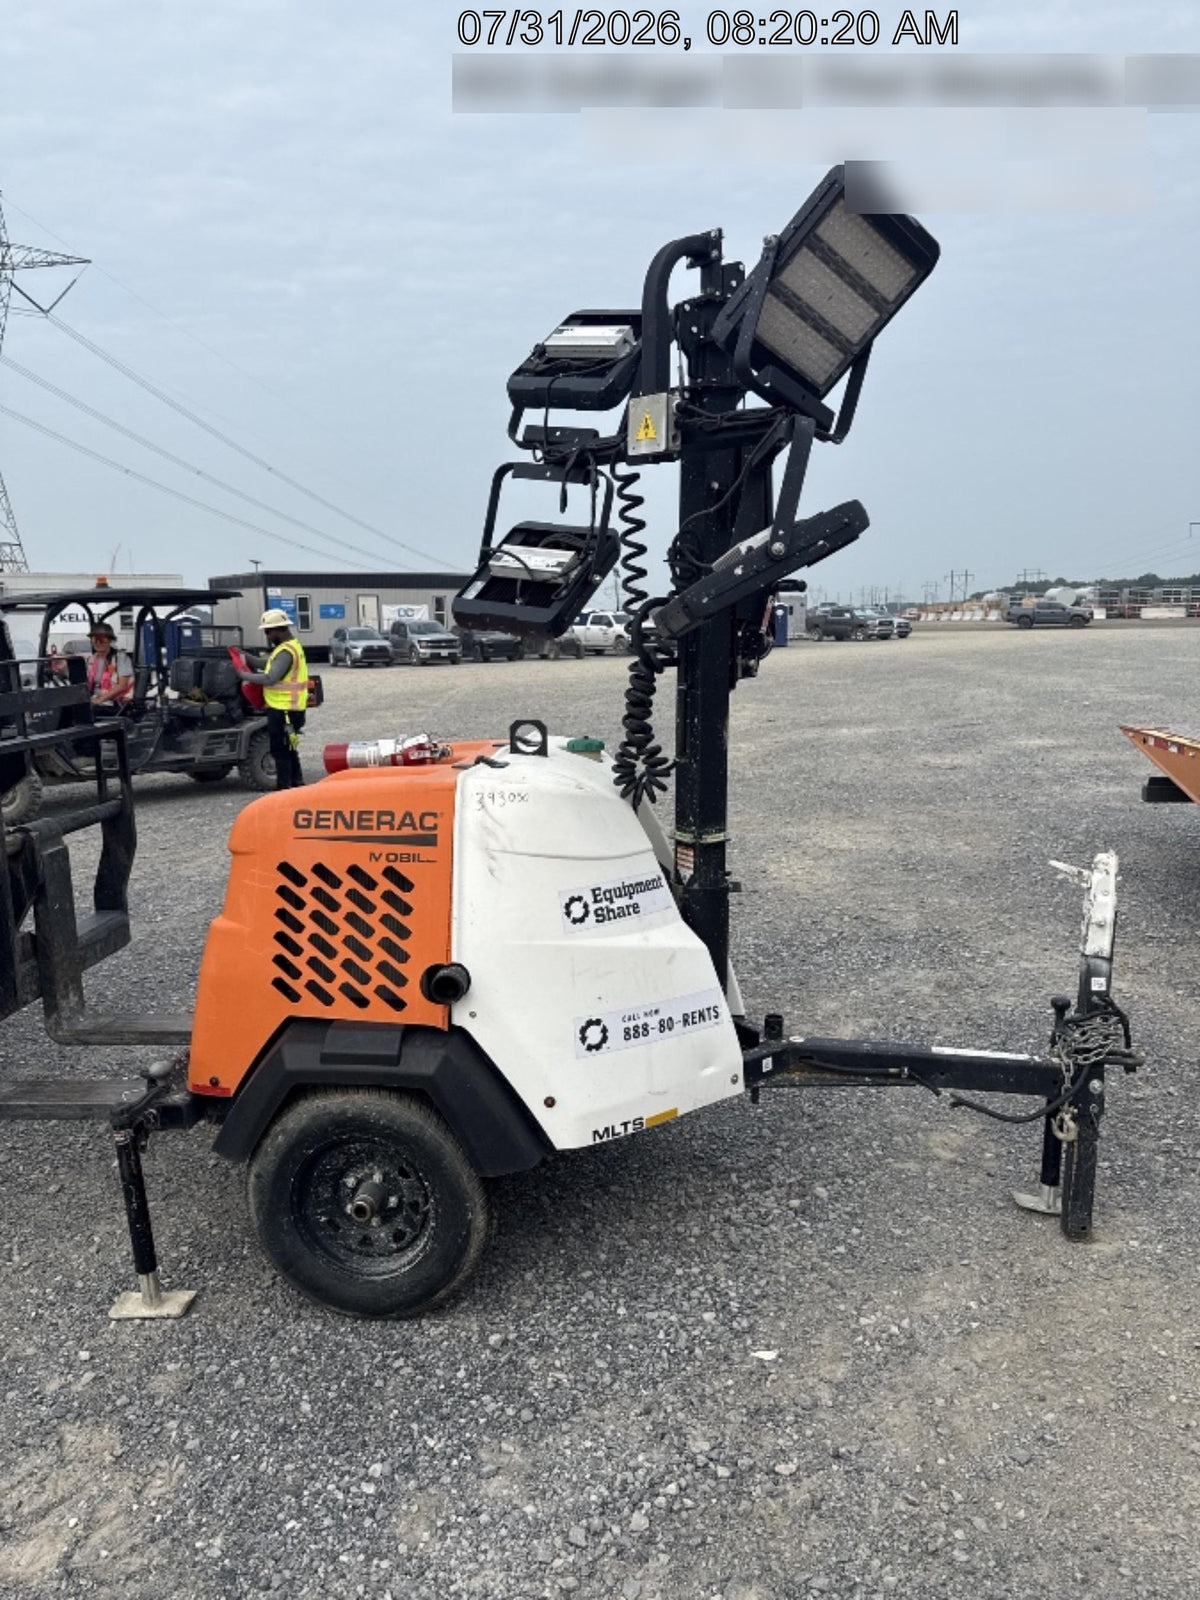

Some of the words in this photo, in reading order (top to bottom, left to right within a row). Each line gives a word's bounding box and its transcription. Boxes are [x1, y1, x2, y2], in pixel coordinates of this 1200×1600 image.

[60, 611, 104, 623] KELL
[292, 808, 439, 832] GENERAC
[368, 852, 438, 863] MOBIL
[590, 875, 664, 905] Equipment
[593, 901, 641, 924] Share
[622, 1005, 720, 1041] 888-80-RENTS
[592, 1116, 645, 1142] MLTS
